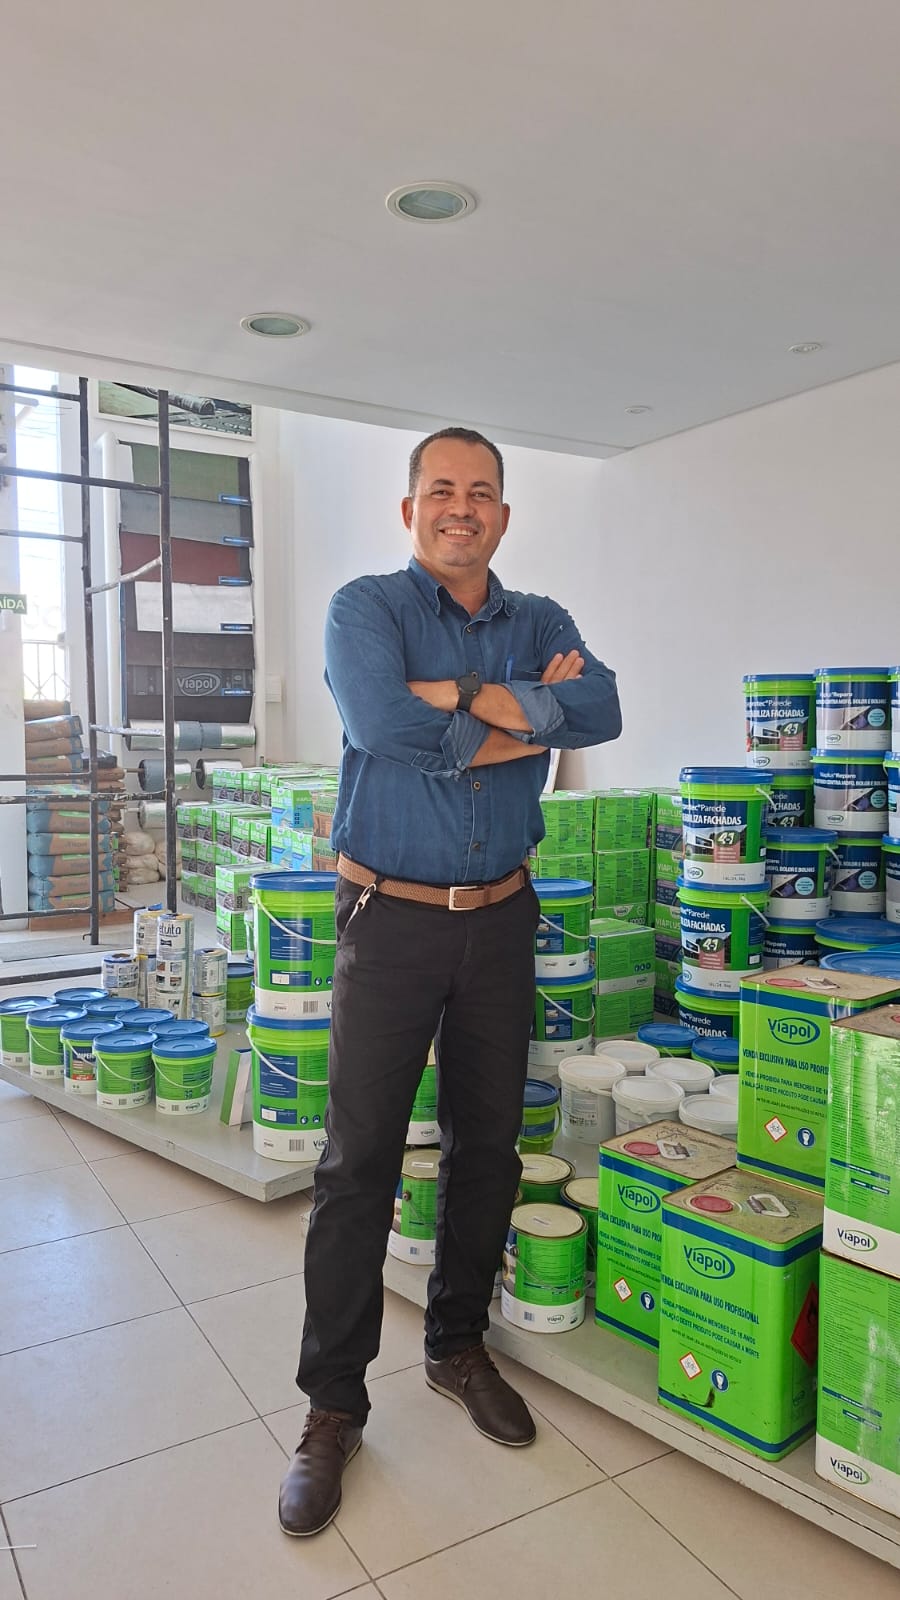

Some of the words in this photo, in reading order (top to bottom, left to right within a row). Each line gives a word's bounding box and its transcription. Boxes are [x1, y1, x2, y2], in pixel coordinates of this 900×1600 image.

[176, 678, 212, 692] Viapol
[770, 709, 804, 718] FACHADAS
[700, 804, 726, 812] Parede
[704, 815, 742, 824] FACHADAS
[691, 920, 726, 932] FACHADAS
[768, 1018, 810, 1040] Viapol
[760, 1052, 784, 1065] EXCLUSIVA
[785, 1058, 798, 1068] PARA
[798, 1060, 808, 1070] USO
[618, 1184, 652, 1208] Viapol
[836, 1227, 870, 1248] Viapol
[684, 1244, 726, 1274] Viapol
[674, 1280, 700, 1298] EXCLUSIVA
[700, 1290, 712, 1304] PARA
[713, 1296, 724, 1309] USO
[724, 1300, 760, 1326] PROFISSIONAL
[830, 1456, 863, 1482] Viapol
